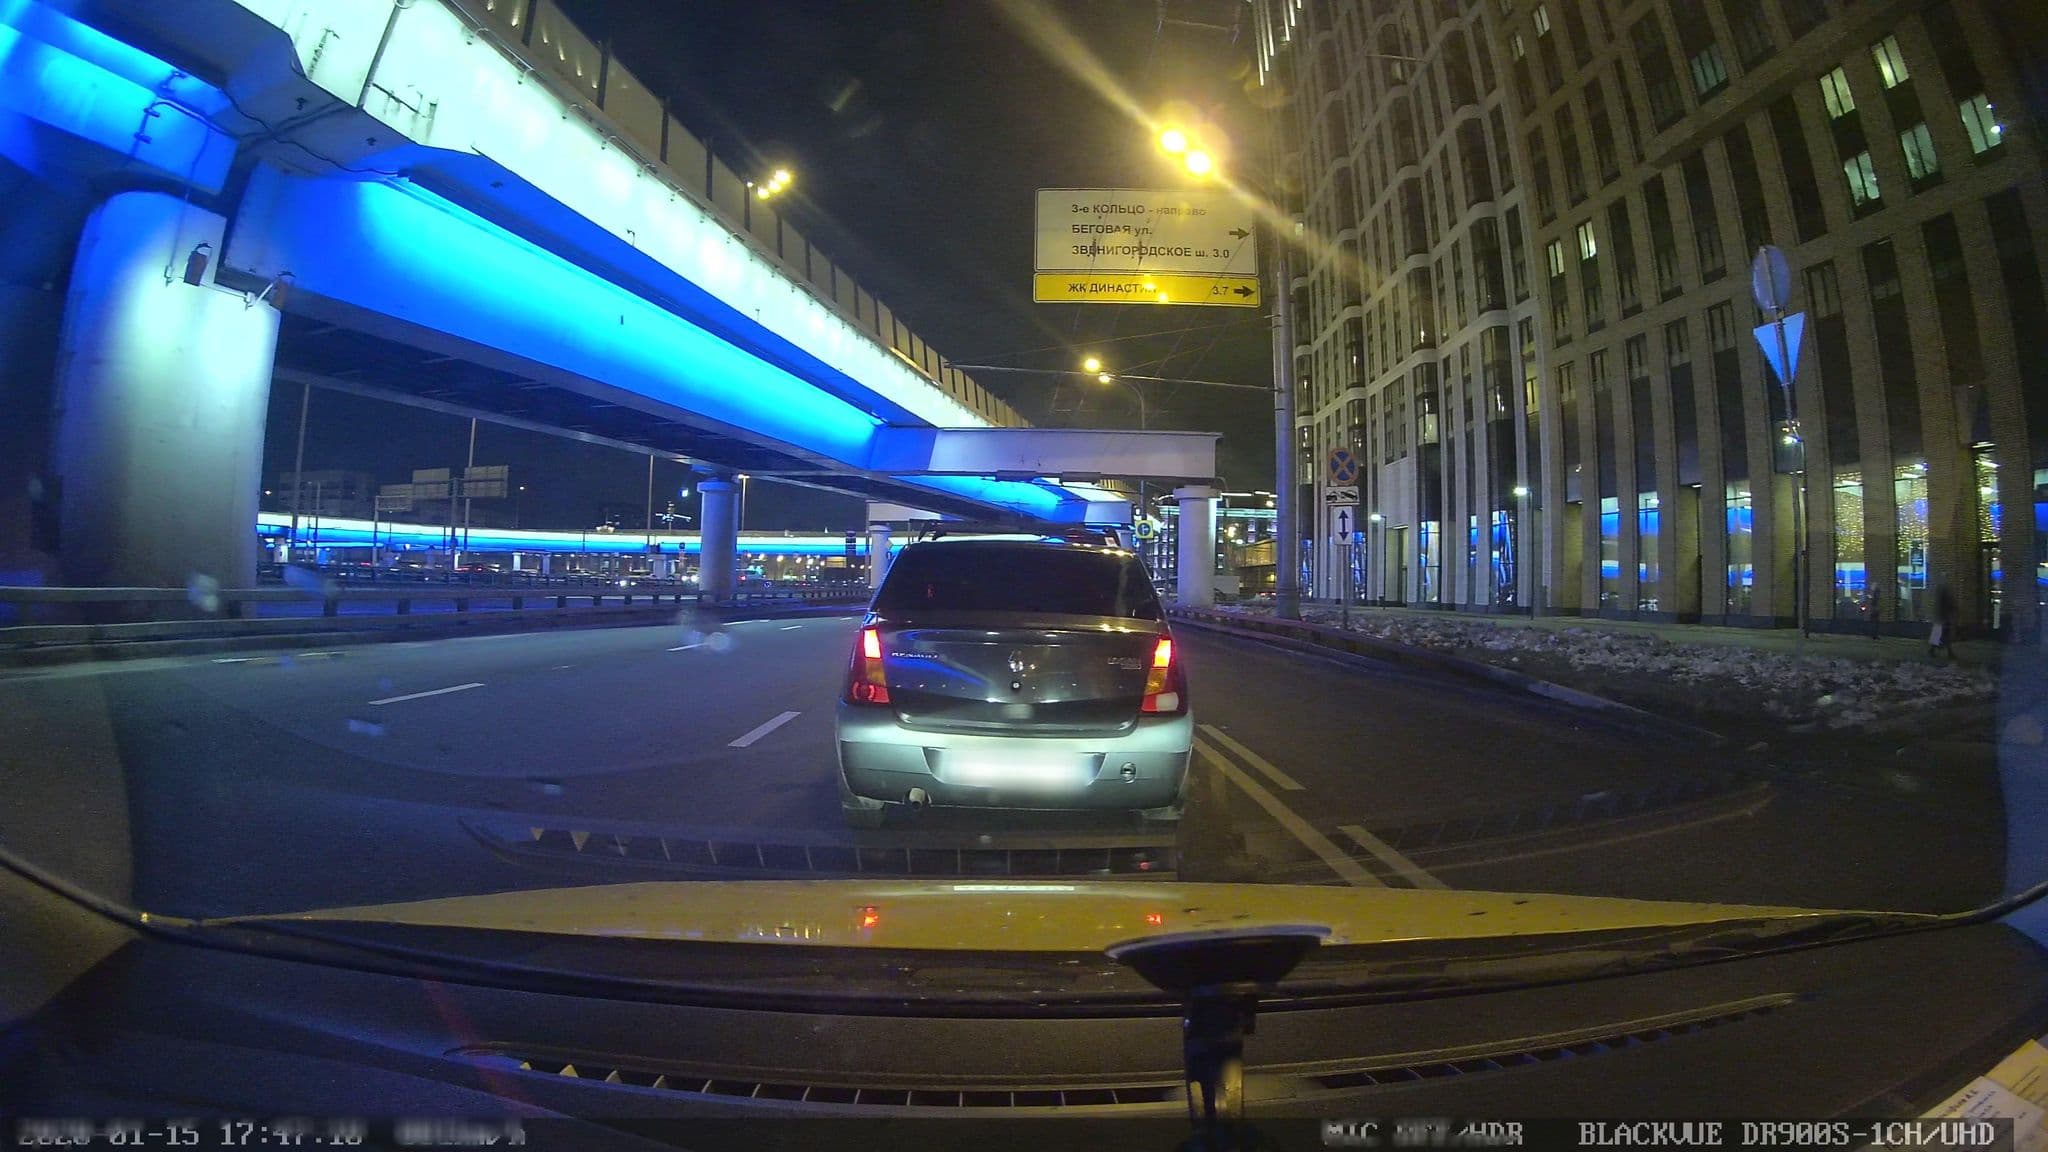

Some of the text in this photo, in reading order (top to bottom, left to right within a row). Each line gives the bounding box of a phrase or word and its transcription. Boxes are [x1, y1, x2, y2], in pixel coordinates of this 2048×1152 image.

[1093, 204, 1145, 216] КОЛЬЦО
[1072, 224, 1153, 238] БЕГОВАЯ ул.
[1072, 245, 1191, 257] ЗВЕНИГОРОДСКОЕ
[1213, 249, 1230, 258] 3.0
[1068, 283, 1087, 293] ЖК
[1213, 286, 1229, 295] 3.7
